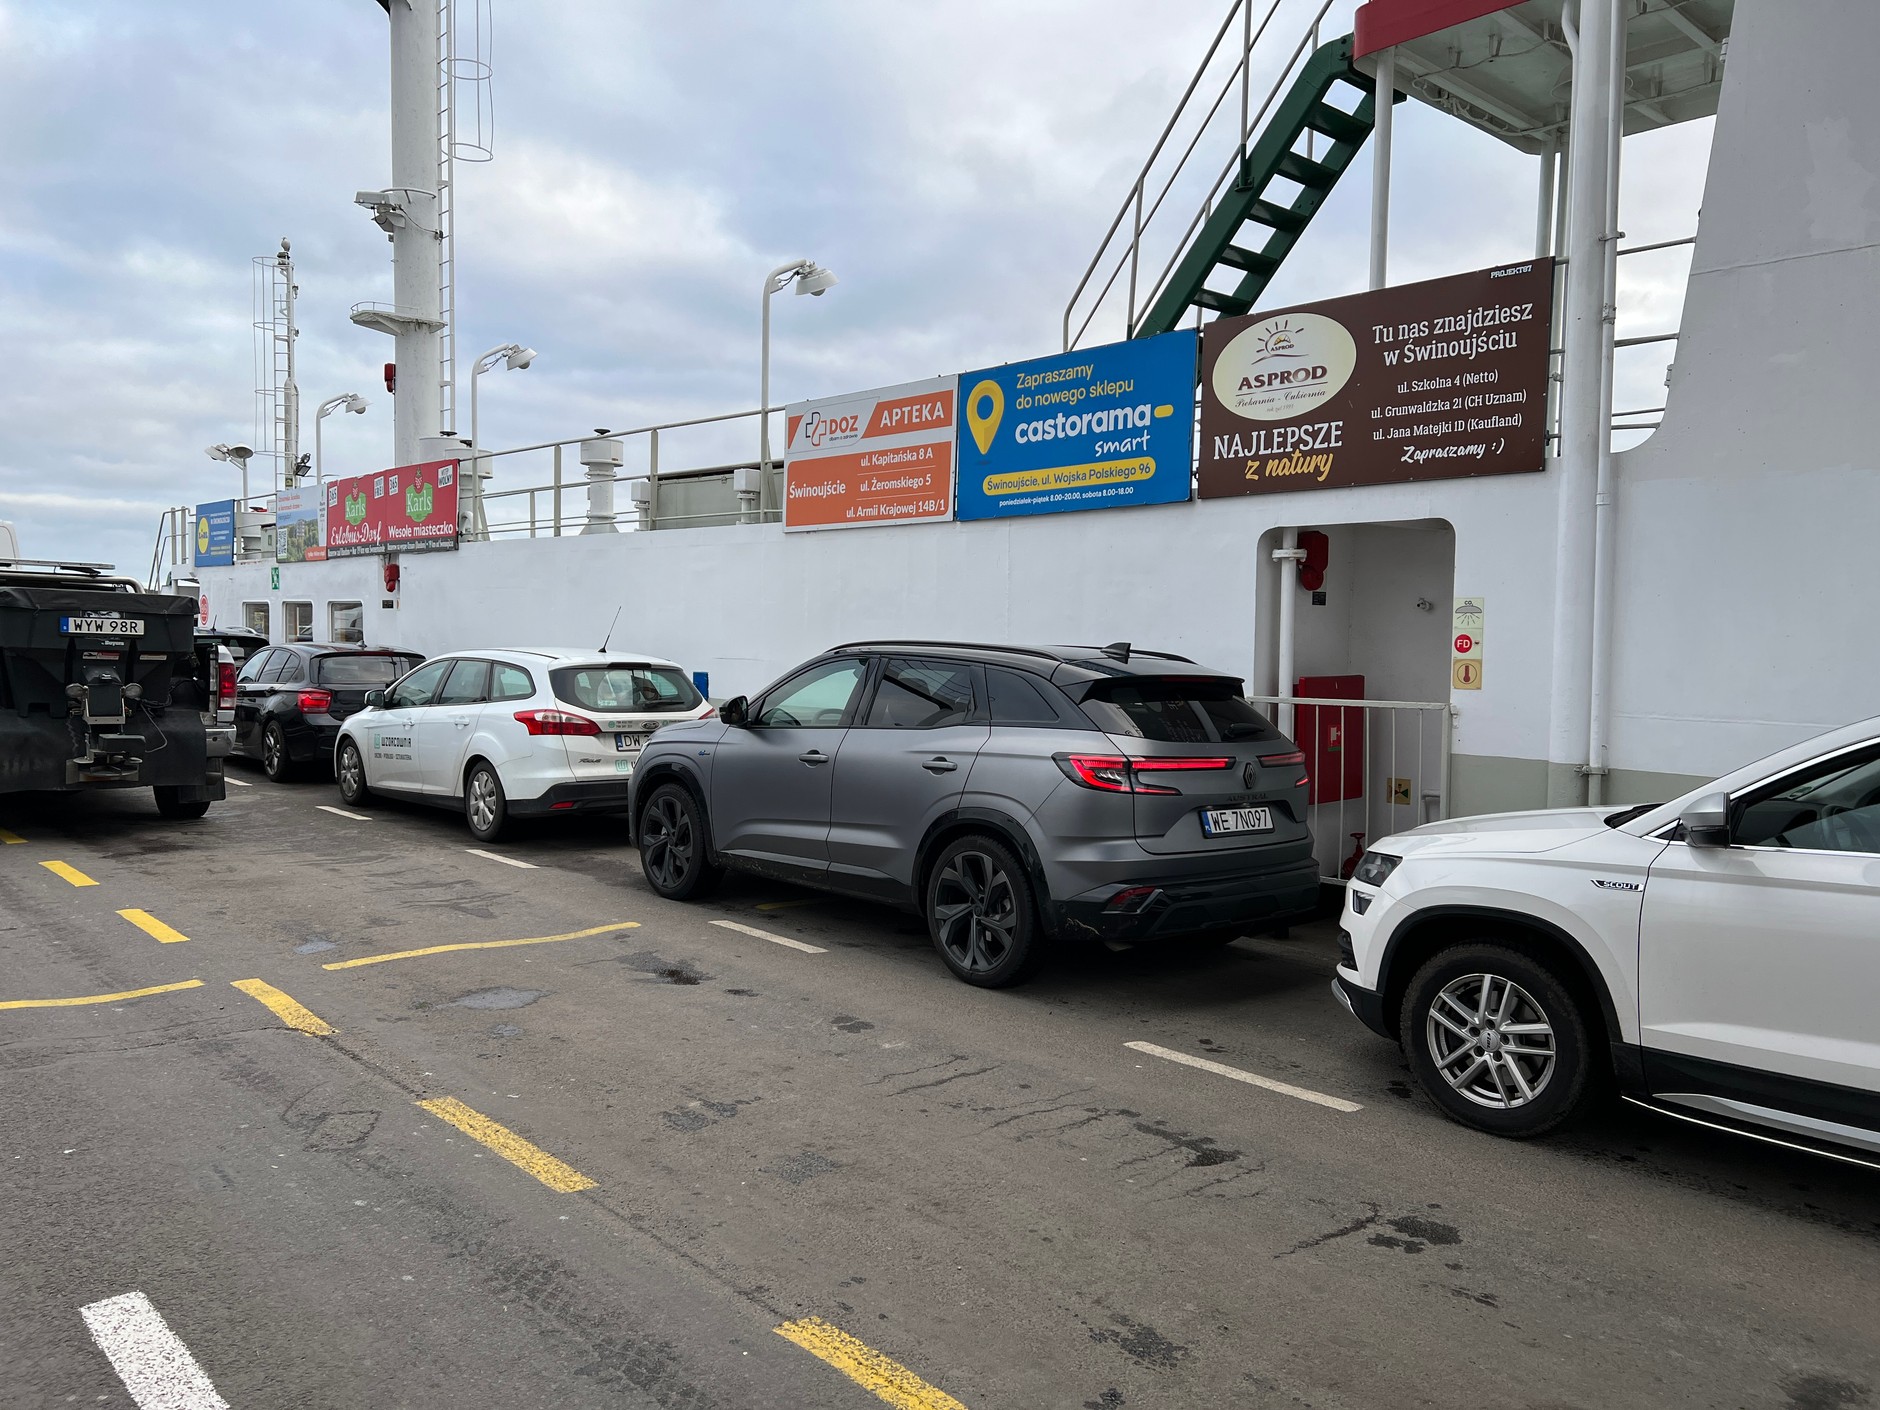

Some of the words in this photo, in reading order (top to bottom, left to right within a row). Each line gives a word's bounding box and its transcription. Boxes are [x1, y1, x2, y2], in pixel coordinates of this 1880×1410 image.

[1490, 265, 1532, 279] PROJEKT87
[1372, 324, 1393, 344] Tu
[1398, 321, 1429, 340] nas
[1434, 303, 1533, 335] znajdziesz
[1384, 350, 1400, 366] w
[1404, 330, 1517, 363] Świnoujściu
[1016, 364, 1094, 390] Zapraszamy
[1238, 365, 1328, 391] ASPROD
[1397, 382, 1409, 393] ul.
[1411, 377, 1451, 392] Szkolna
[1454, 375, 1460, 386] 4
[1463, 369, 1498, 387] (Netto)
[1016, 395, 1032, 410] do
[1035, 387, 1086, 407] nowego
[1089, 379, 1134, 399] sklepu
[1284, 390, 1326, 401] Cukiernia
[1371, 407, 1383, 418] ul.
[1385, 400, 1450, 417] Grunwaldzka
[1453, 398, 1462, 409] 21
[1464, 396, 1482, 410] (CH
[1486, 389, 1527, 405] Uznam)
[829, 415, 858, 435] DOZ
[880, 401, 944, 428] APTEKA
[1015, 404, 1151, 444] castorama
[1373, 429, 1384, 440] ul.
[1387, 427, 1410, 439] Jana
[1413, 422, 1452, 440] Matejki
[1454, 420, 1465, 431] 1D
[1467, 413, 1522, 432] (Kaufland)
[1095, 430, 1150, 457] smart
[1214, 421, 1343, 460] NAJLEPSZE
[861, 457, 870, 467] ul.
[872, 450, 916, 465] Kapitańska
[919, 448, 924, 459] 8
[926, 447, 933, 458] A
[1401, 443, 1486, 464] Zapraszamy
[1245, 459, 1258, 480] z
[1266, 449, 1334, 482] natury
[860, 482, 870, 492] ul.
[871, 477, 923, 491] Żeromskiego
[926, 474, 931, 485] 5
[987, 474, 1040, 491] Świnoujście,
[1042, 475, 1052, 485] ul.
[1054, 470, 1087, 486] Wojska
[1089, 466, 1136, 480] Polskiego
[1139, 462, 1150, 474] 96
[789, 480, 846, 499] Świnoujście
[1082, 490, 1101, 499] sobota
[1103, 487, 1134, 496] 8.00-18.00
[346, 498, 366, 518] Karls
[406, 490, 432, 512] Karls
[846, 508, 855, 518] ul.
[857, 504, 878, 517] Armii
[880, 502, 916, 516] Krajowej
[918, 499, 945, 512] 14B/1
[413, 521, 453, 536] miasteczko
[74, 619, 104, 632] WYW
[109, 621, 138, 633] 98R
[1456, 640, 1470, 648] FD
[624, 735, 640, 747] DW
[1211, 812, 1230, 831] WE
[1232, 810, 1267, 830] 7N097
[1604, 881, 1638, 890] SCOUT
